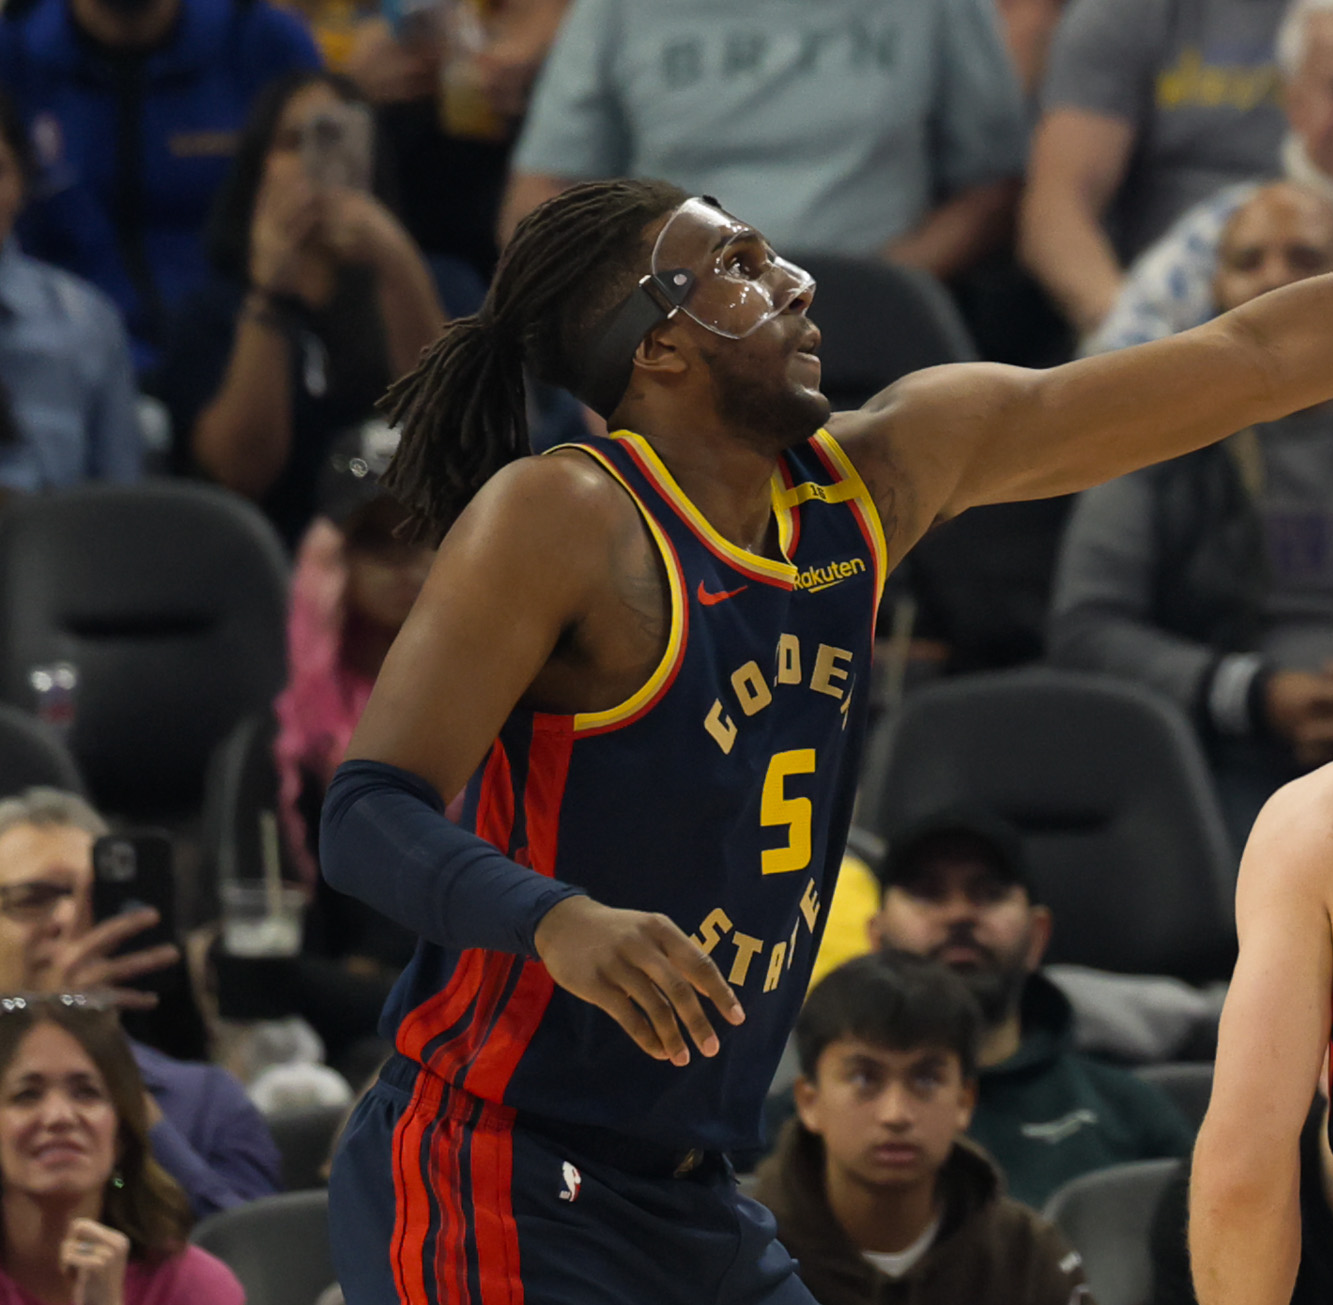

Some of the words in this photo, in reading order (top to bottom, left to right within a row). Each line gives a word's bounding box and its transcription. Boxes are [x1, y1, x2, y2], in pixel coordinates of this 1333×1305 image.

[793, 557, 867, 591] Rakuten
[703, 632, 857, 756] GODE
[760, 747, 817, 875] 5
[689, 877, 821, 993] STAE
